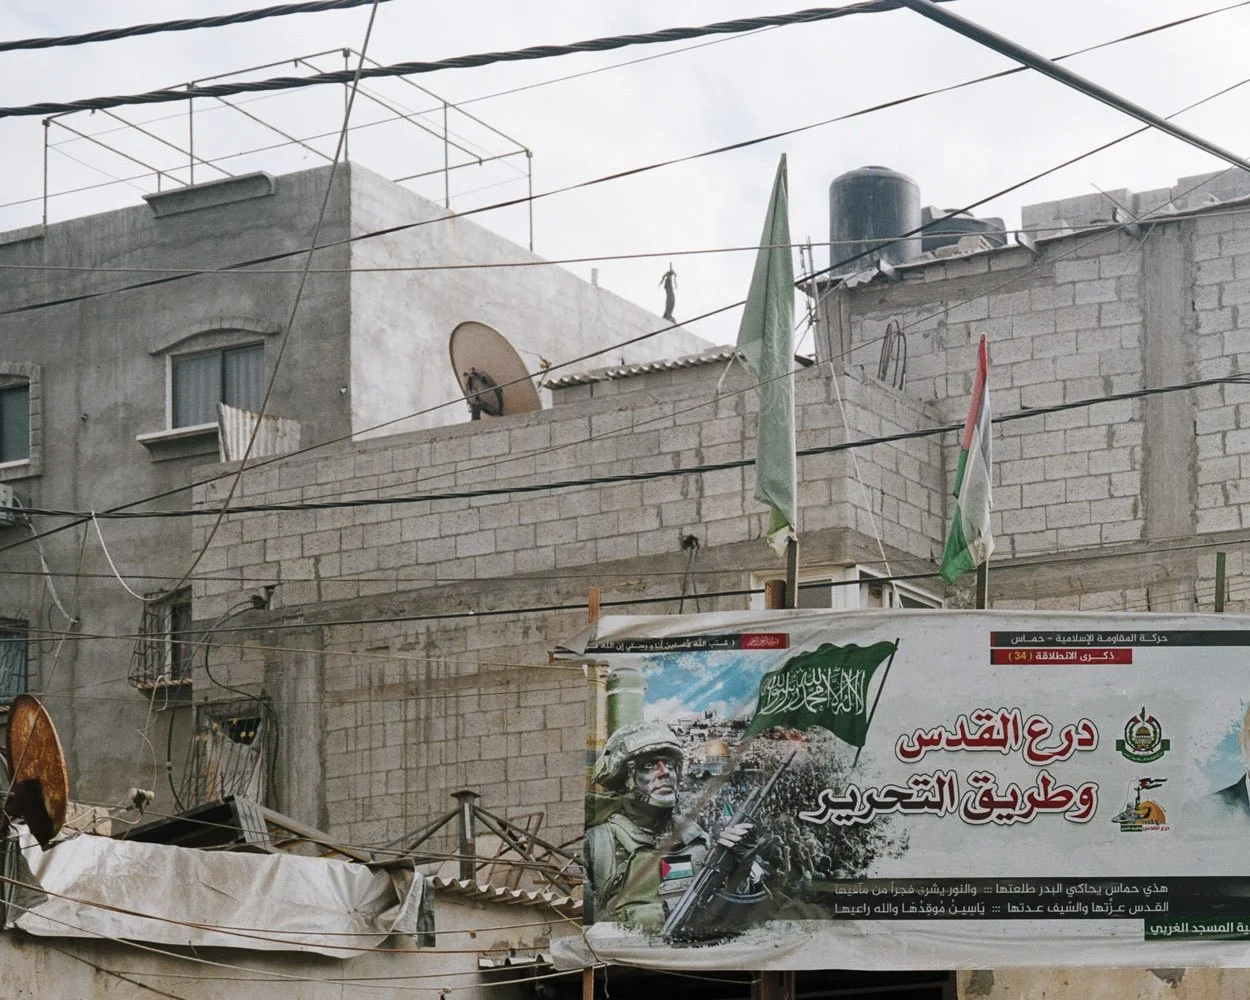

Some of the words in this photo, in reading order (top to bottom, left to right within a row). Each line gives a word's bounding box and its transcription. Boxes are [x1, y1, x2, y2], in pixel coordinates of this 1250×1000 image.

[1010, 634, 1045, 645] حماس
[1055, 634, 1095, 646] الإسلامية
[1096, 634, 1137, 645] المقاومة
[1139, 634, 1168, 644] حركة
[1035, 651, 1077, 661] الانطلاقة
[1079, 652, 1115, 662] ذكرى
[897, 710, 1021, 761] القدس
[1022, 716, 1097, 764] درع
[802, 772, 960, 823] التحرير
[961, 772, 1097, 822] وطريق
[871, 885, 888, 896] من
[917, 883, 945, 896] يشرق
[948, 883, 977, 897] والنور
[995, 883, 1036, 894] طلعتها
[1038, 883, 1063, 896] البدر
[1065, 883, 1102, 898] يحاكي
[1105, 882, 1140, 896] حماس
[1142, 883, 1169, 898] هذي
[834, 902, 871, 917] راعيها
[873, 902, 899, 916] والله
[1128, 901, 1169, 915] القدس
[1150, 922, 1189, 936] الغربي
[1191, 922, 1234, 935] المسجد
